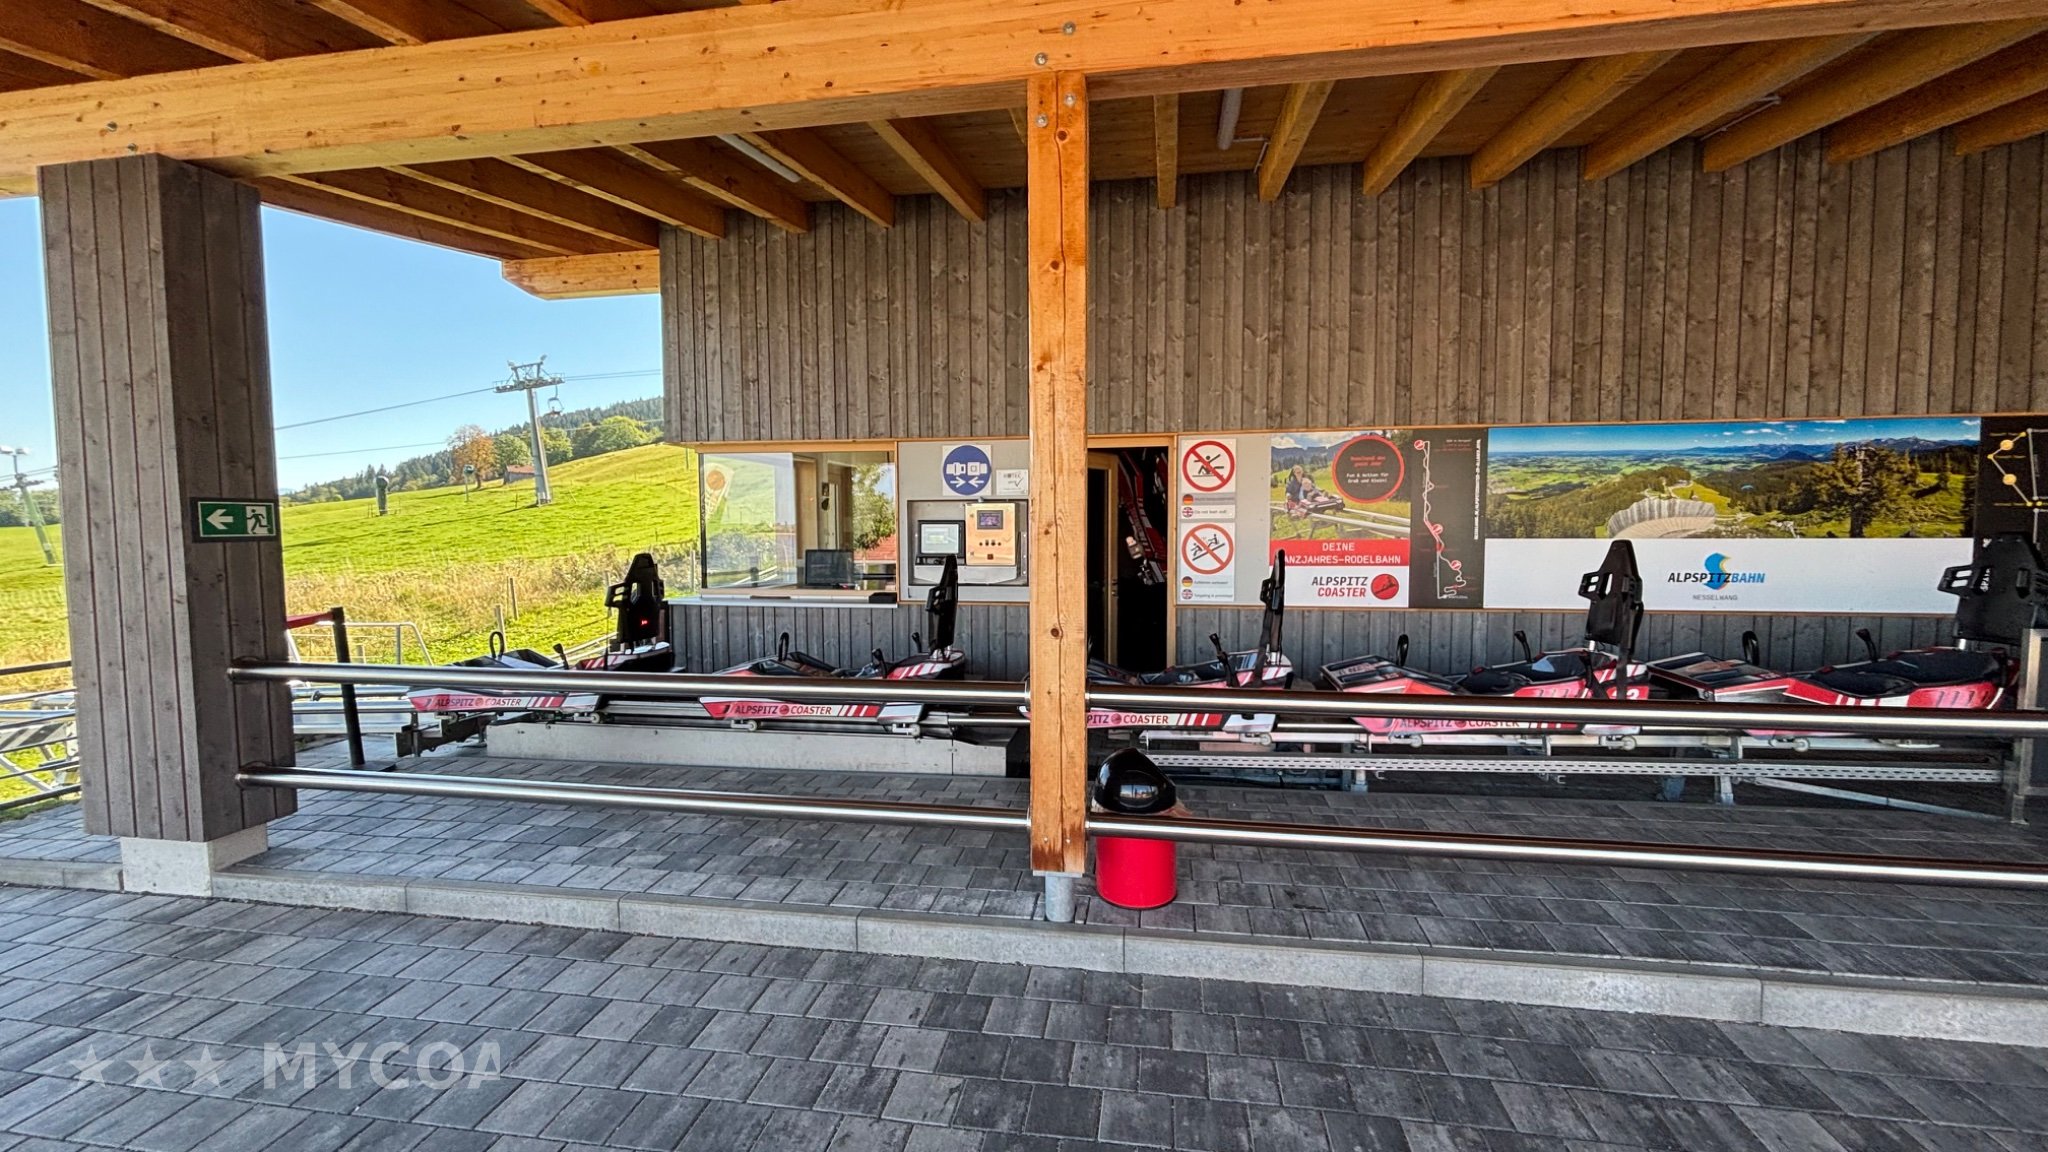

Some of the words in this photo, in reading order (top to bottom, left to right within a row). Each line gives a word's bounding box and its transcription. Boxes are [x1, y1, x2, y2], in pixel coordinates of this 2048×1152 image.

[1322, 542, 1355, 552] DEINE
[1284, 555, 1401, 564] ANZJAHRES-RODELBAHN
[1311, 576, 1368, 586] ALPSPITZ
[1667, 572, 1766, 583] ALPSPITZBAHN
[1317, 587, 1367, 597] COASTER
[435, 698, 474, 707] ALPSPITZ
[485, 698, 522, 706] COASTER
[734, 705, 779, 714] ALPSPITZ
[790, 705, 832, 715] COASTER
[1086, 714, 1109, 724] PITZ
[1123, 714, 1169, 724] COASTER
[1399, 718, 1453, 728] ALPSPITZ
